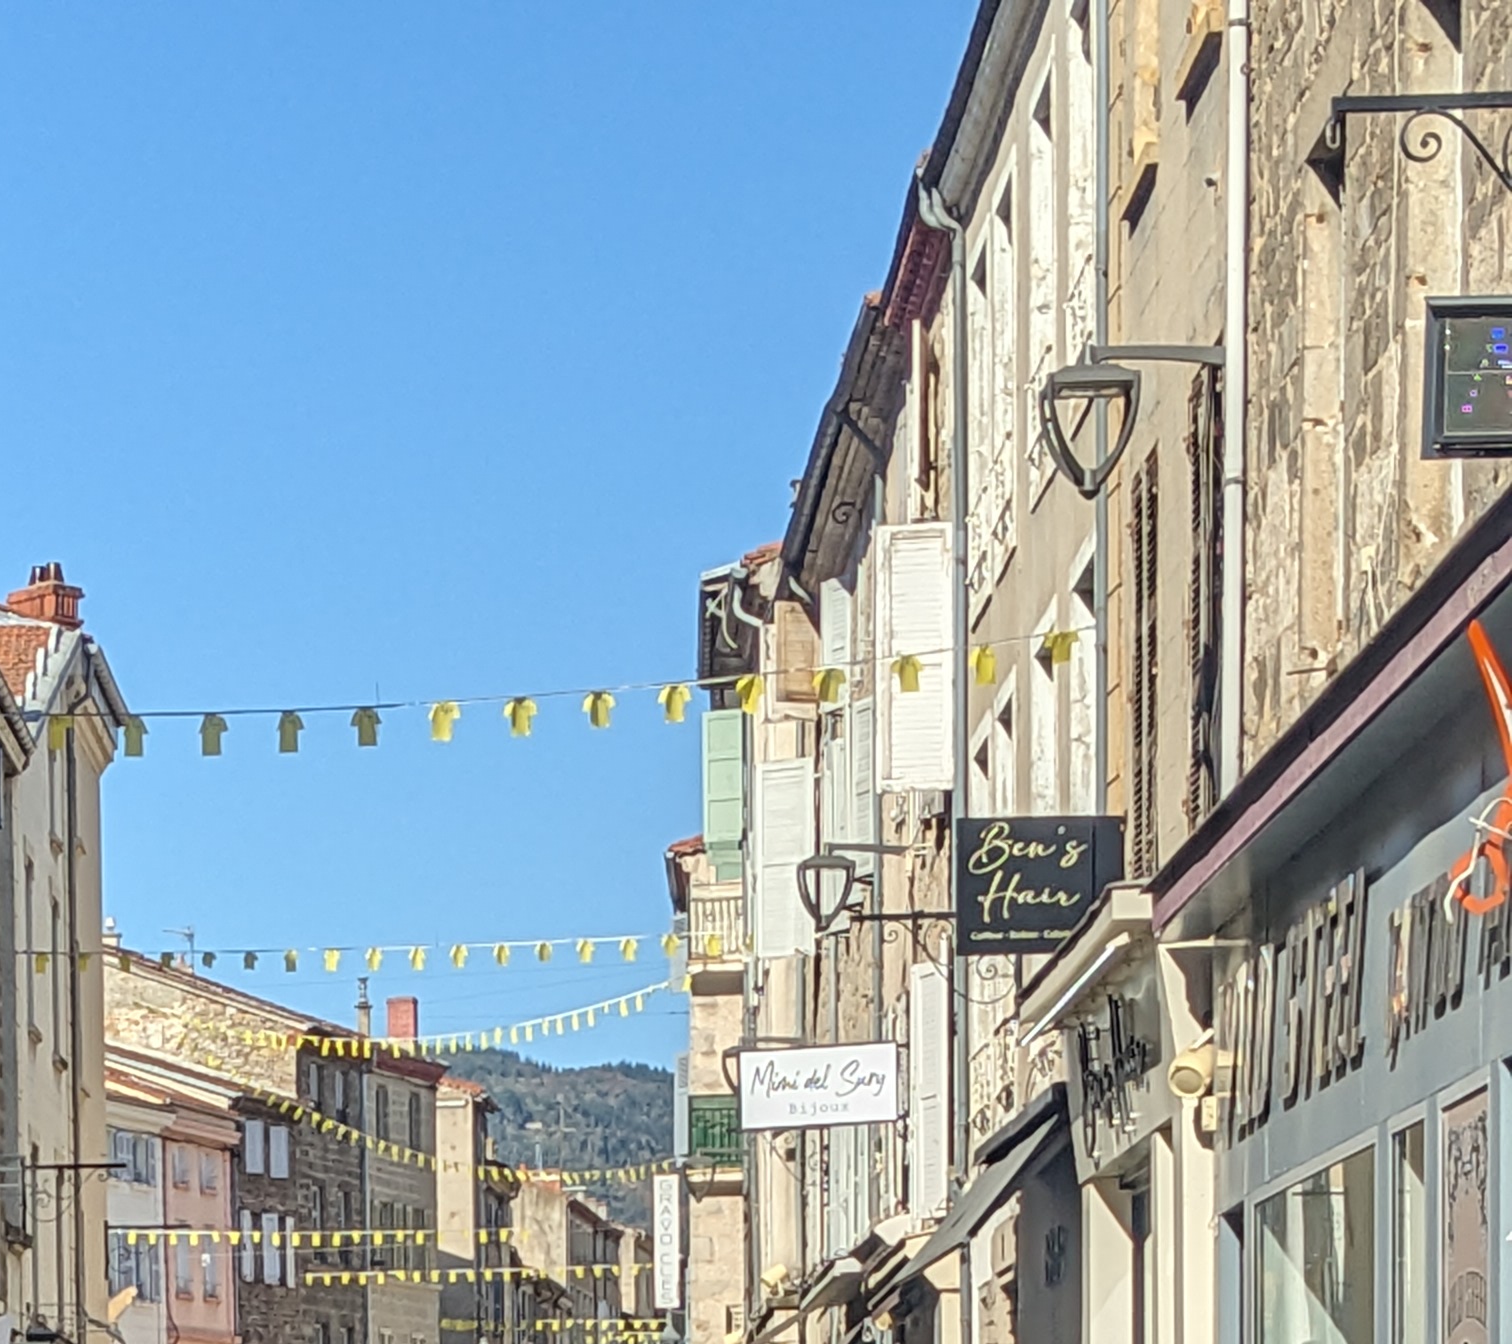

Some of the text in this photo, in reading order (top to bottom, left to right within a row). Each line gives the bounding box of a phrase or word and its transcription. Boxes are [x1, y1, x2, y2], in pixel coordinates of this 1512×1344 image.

[968, 821, 1088, 875] Ben's
[977, 869, 1081, 924] Hair
[750, 1059, 800, 1098] Mimi
[804, 1064, 831, 1091] del
[788, 1102, 850, 1117] Bijoux
[659, 1179, 674, 1247] GRAVO
